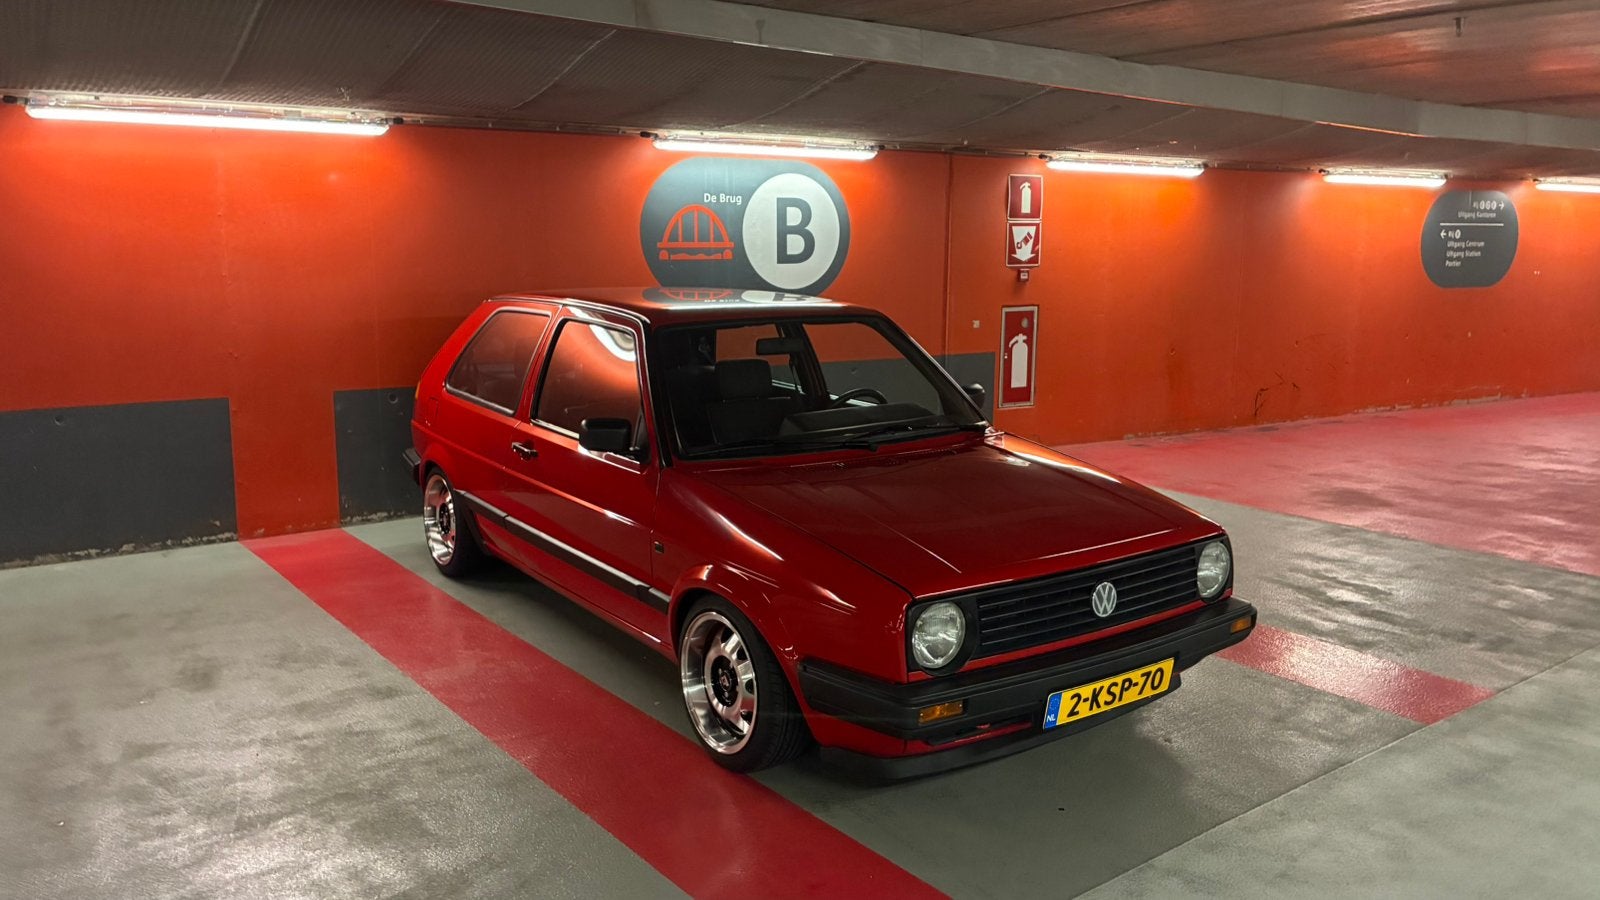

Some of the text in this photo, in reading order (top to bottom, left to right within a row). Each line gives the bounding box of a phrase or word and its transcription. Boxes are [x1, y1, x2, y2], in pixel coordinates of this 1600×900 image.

[703, 192, 742, 205] De Brug
[777, 197, 816, 265] B
[1067, 667, 1164, 718] 2-KSP-70
[1046, 713, 1056, 722] NL
